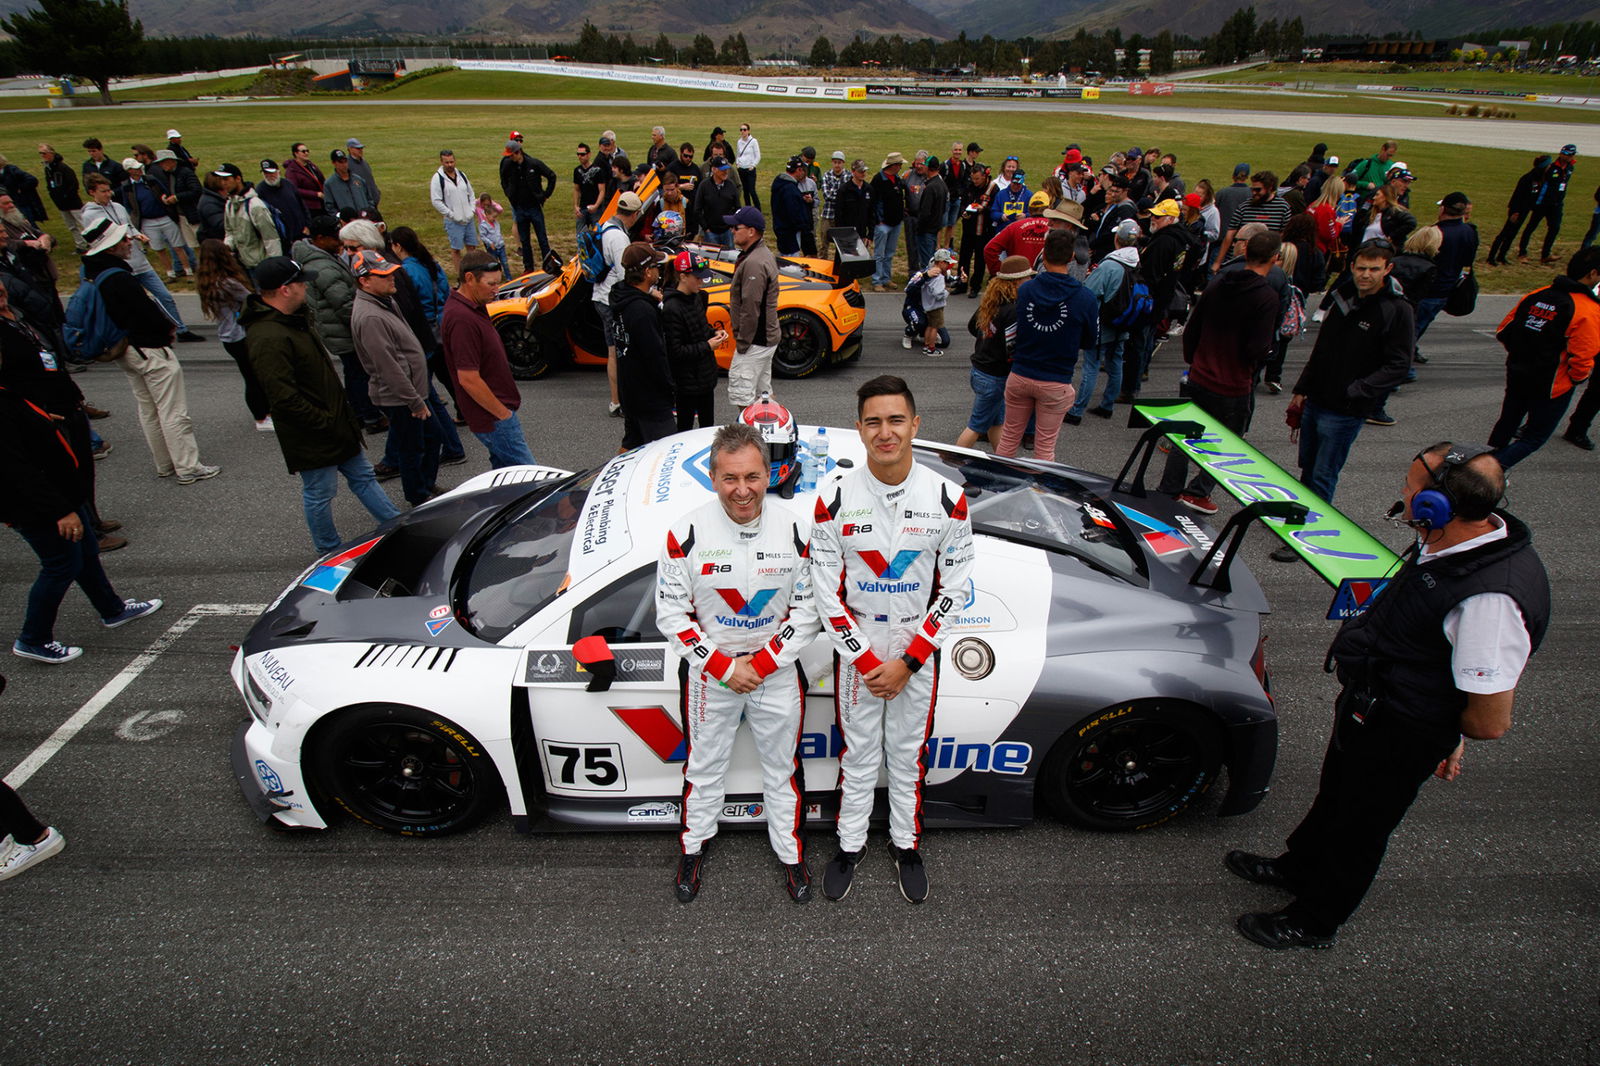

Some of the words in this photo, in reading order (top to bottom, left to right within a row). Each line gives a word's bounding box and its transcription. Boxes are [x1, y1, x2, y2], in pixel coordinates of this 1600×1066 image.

[594, 456, 635, 497] Laser
[655, 455, 678, 503] ROBINSON
[594, 498, 615, 546] Plumbing
[913, 511, 930, 519] MILES
[857, 581, 920, 594] Valvoline
[715, 615, 776, 630] Valvoline
[930, 596, 953, 629] R8
[835, 624, 862, 653] R8
[260, 651, 295, 692] NUVEAU
[851, 685, 860, 706] Sport
[699, 702, 707, 723] Sport
[430, 720, 480, 757] PIRELLI
[548, 744, 619, 786] 75
[628, 808, 668, 817] cams
[722, 805, 748, 817] elf
